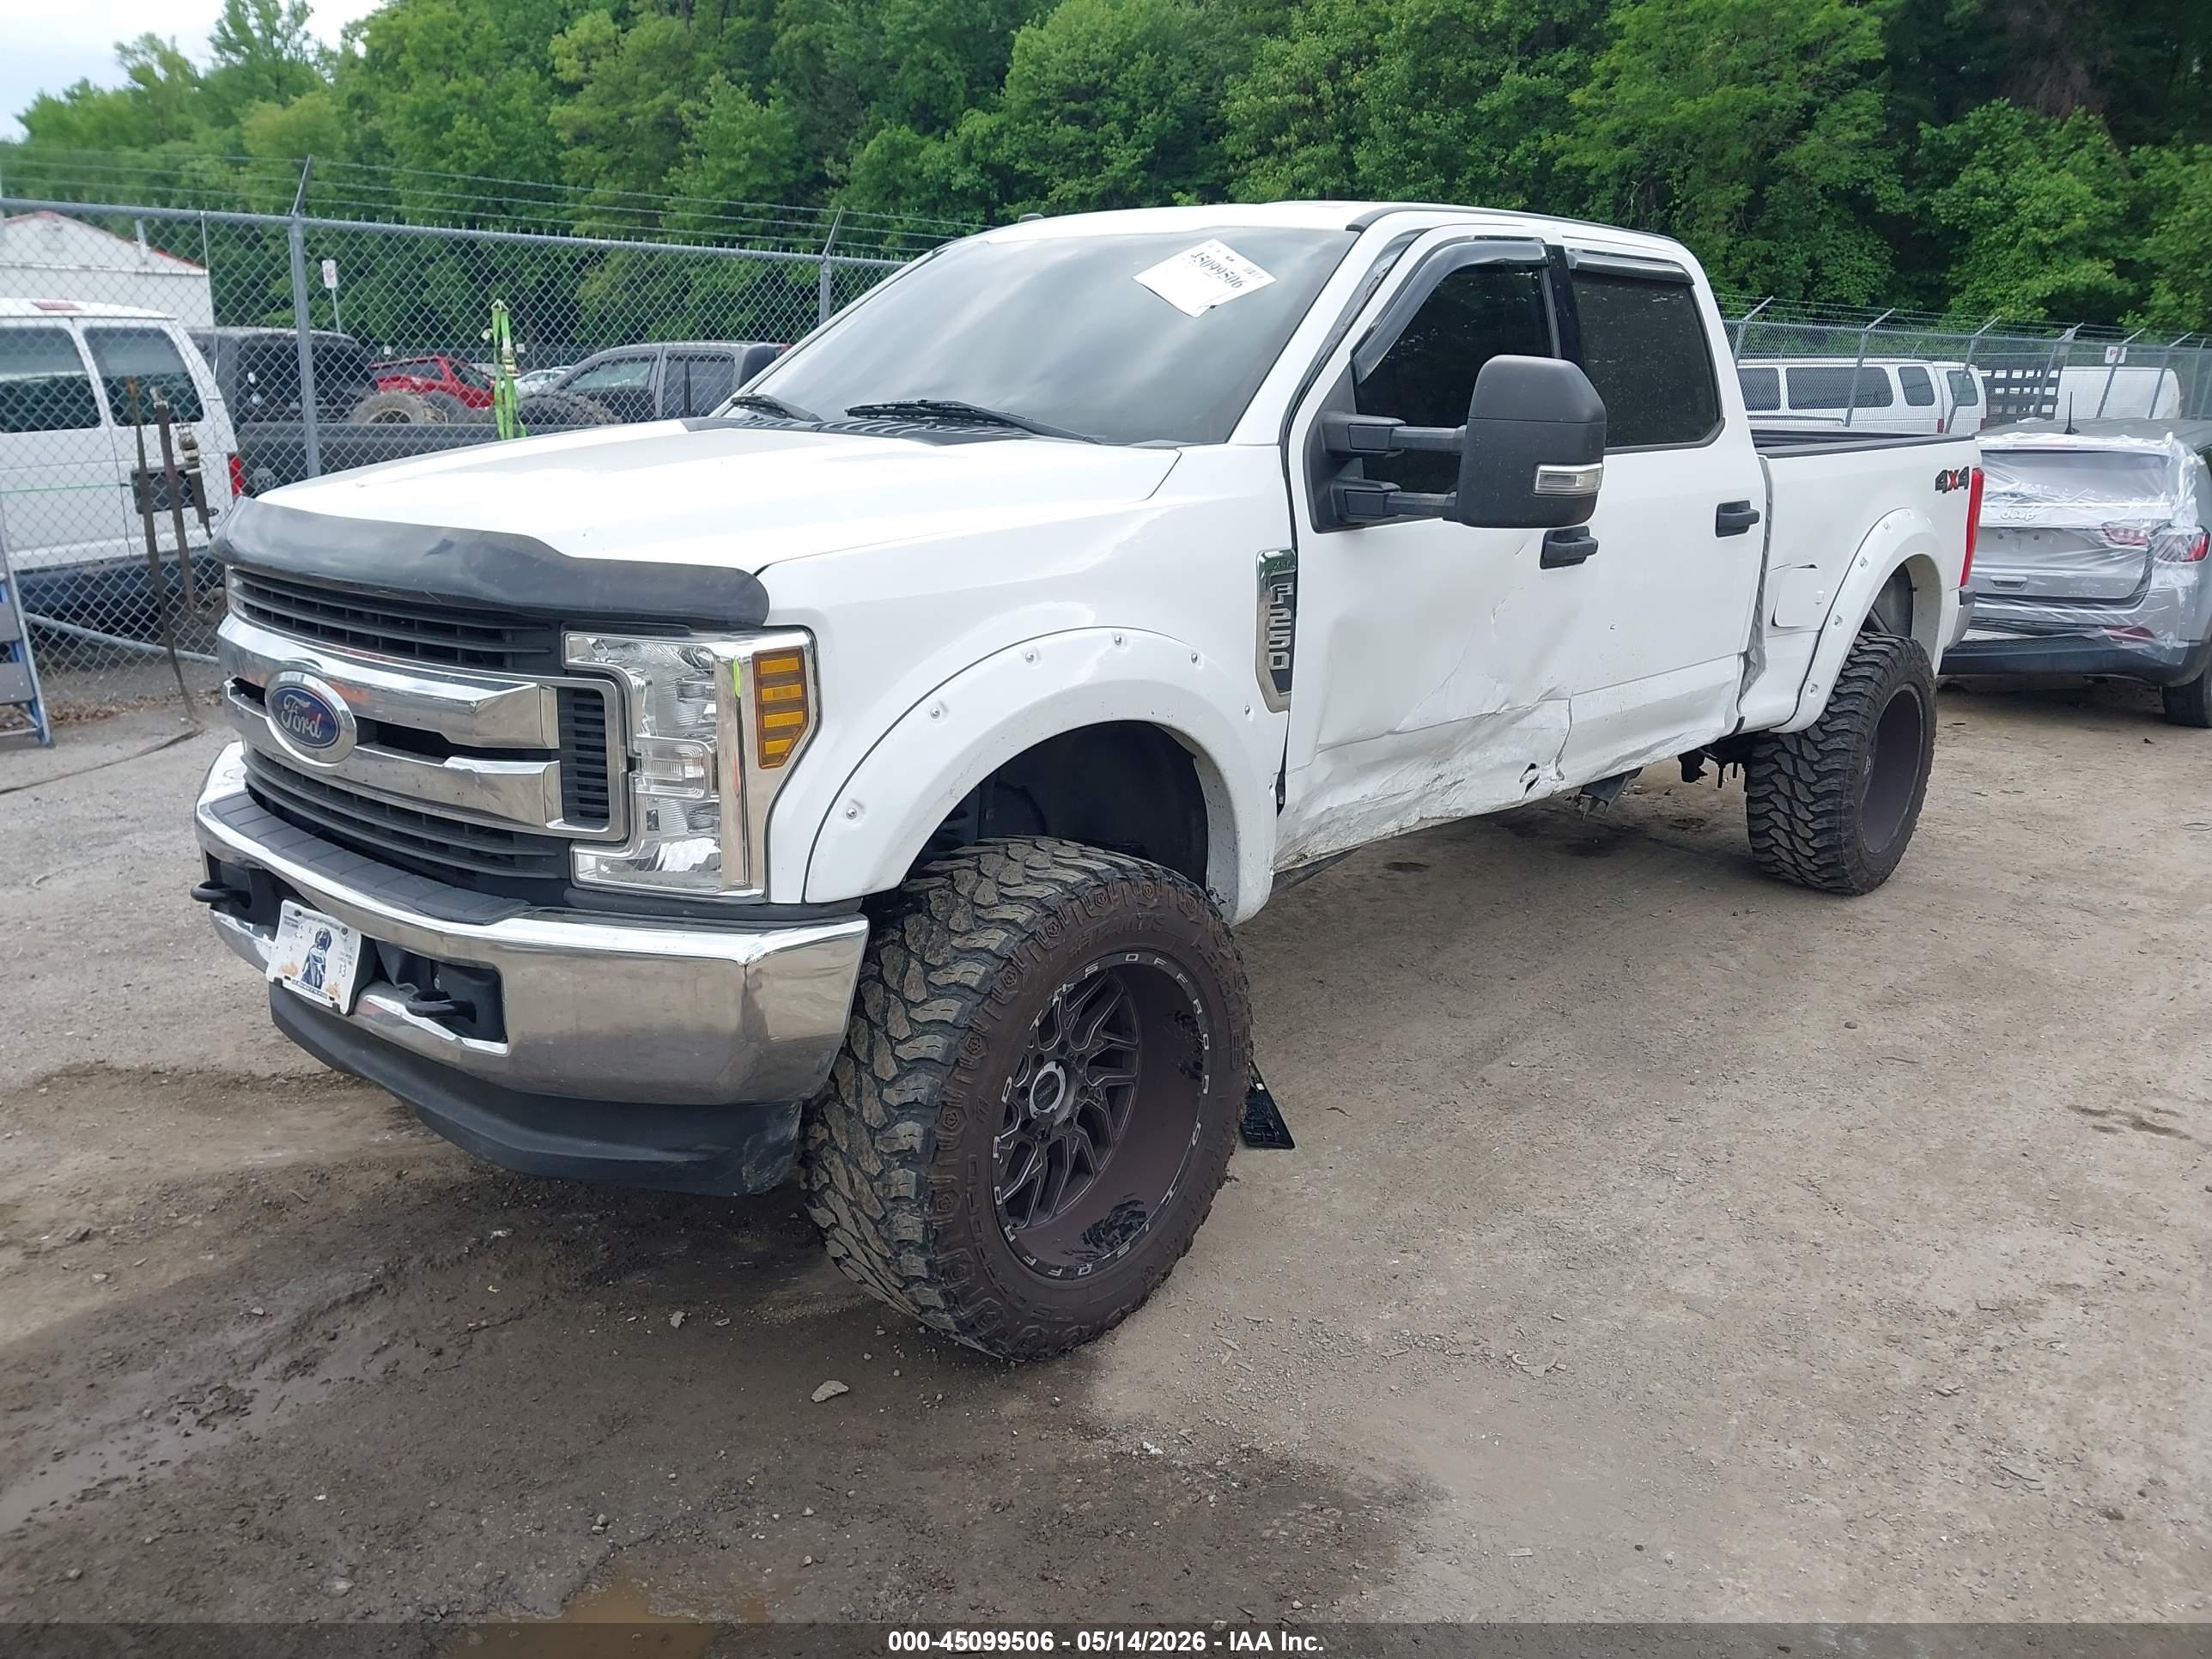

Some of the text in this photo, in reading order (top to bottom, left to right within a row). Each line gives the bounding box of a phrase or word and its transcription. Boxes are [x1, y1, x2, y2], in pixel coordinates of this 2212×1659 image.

[2000, 508, 2035, 522] Jeep
[1268, 582, 1294, 670] F250
[281, 694, 322, 739] Ford
